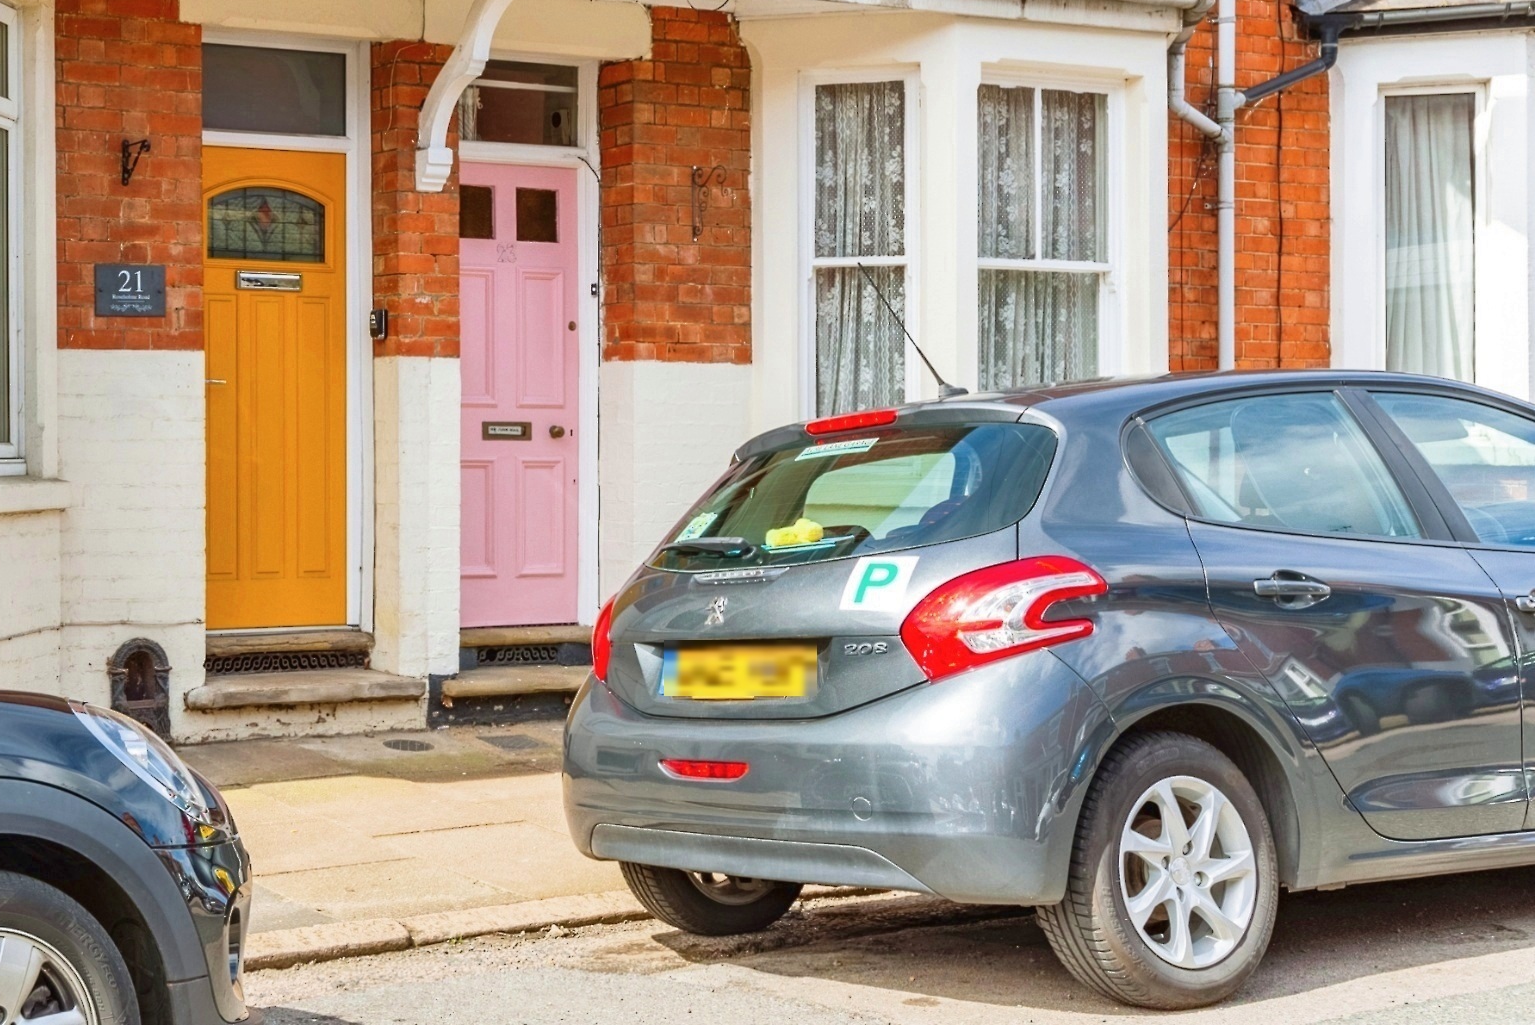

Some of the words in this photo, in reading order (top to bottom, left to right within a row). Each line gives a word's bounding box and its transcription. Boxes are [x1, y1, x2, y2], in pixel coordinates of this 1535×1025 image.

[496, 244, 517, 263] 23
[117, 270, 144, 292] 21
[854, 563, 899, 604] P
[844, 643, 888, 656] 208
